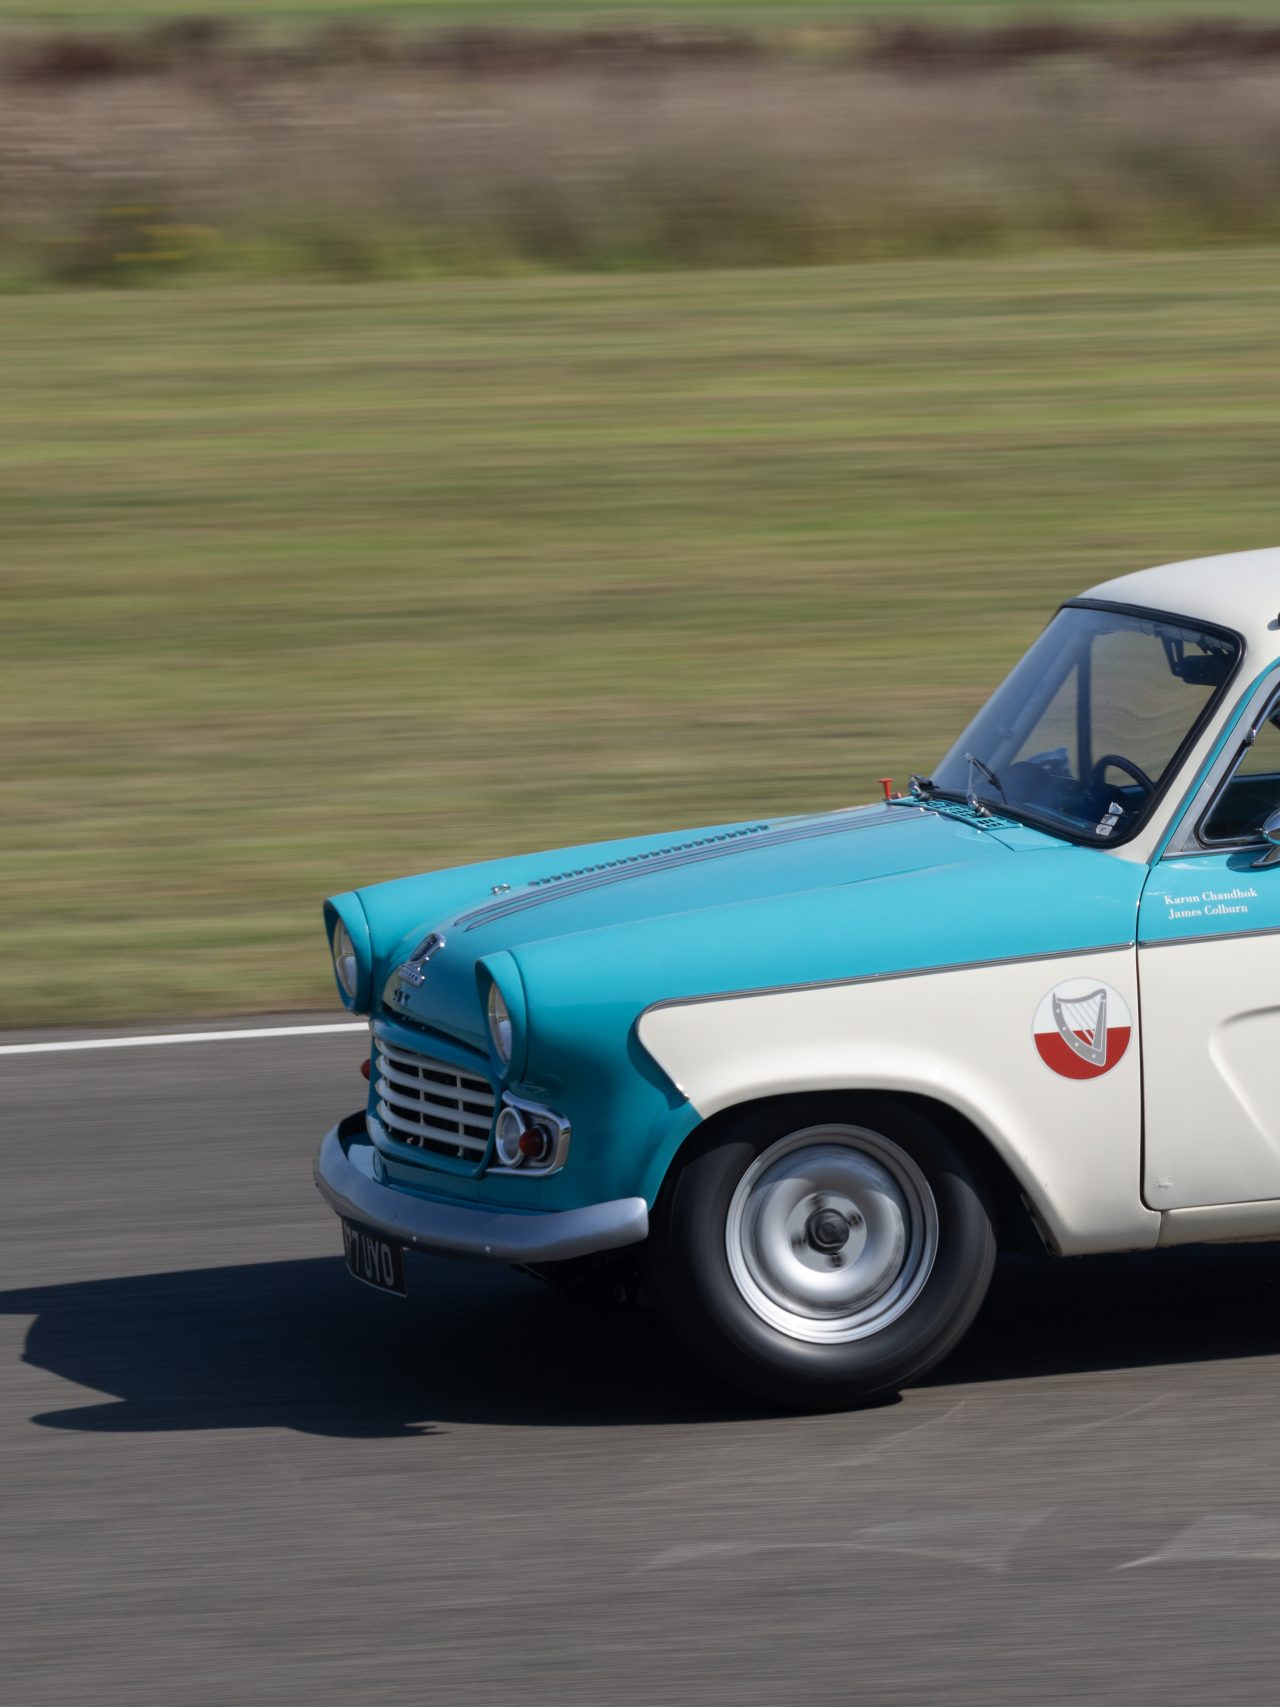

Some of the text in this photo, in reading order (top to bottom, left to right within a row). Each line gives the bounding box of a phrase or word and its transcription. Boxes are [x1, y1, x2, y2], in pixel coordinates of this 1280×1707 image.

[1163, 887, 1258, 905] Karun Chandhok
[1168, 903, 1248, 920] James Colburn
